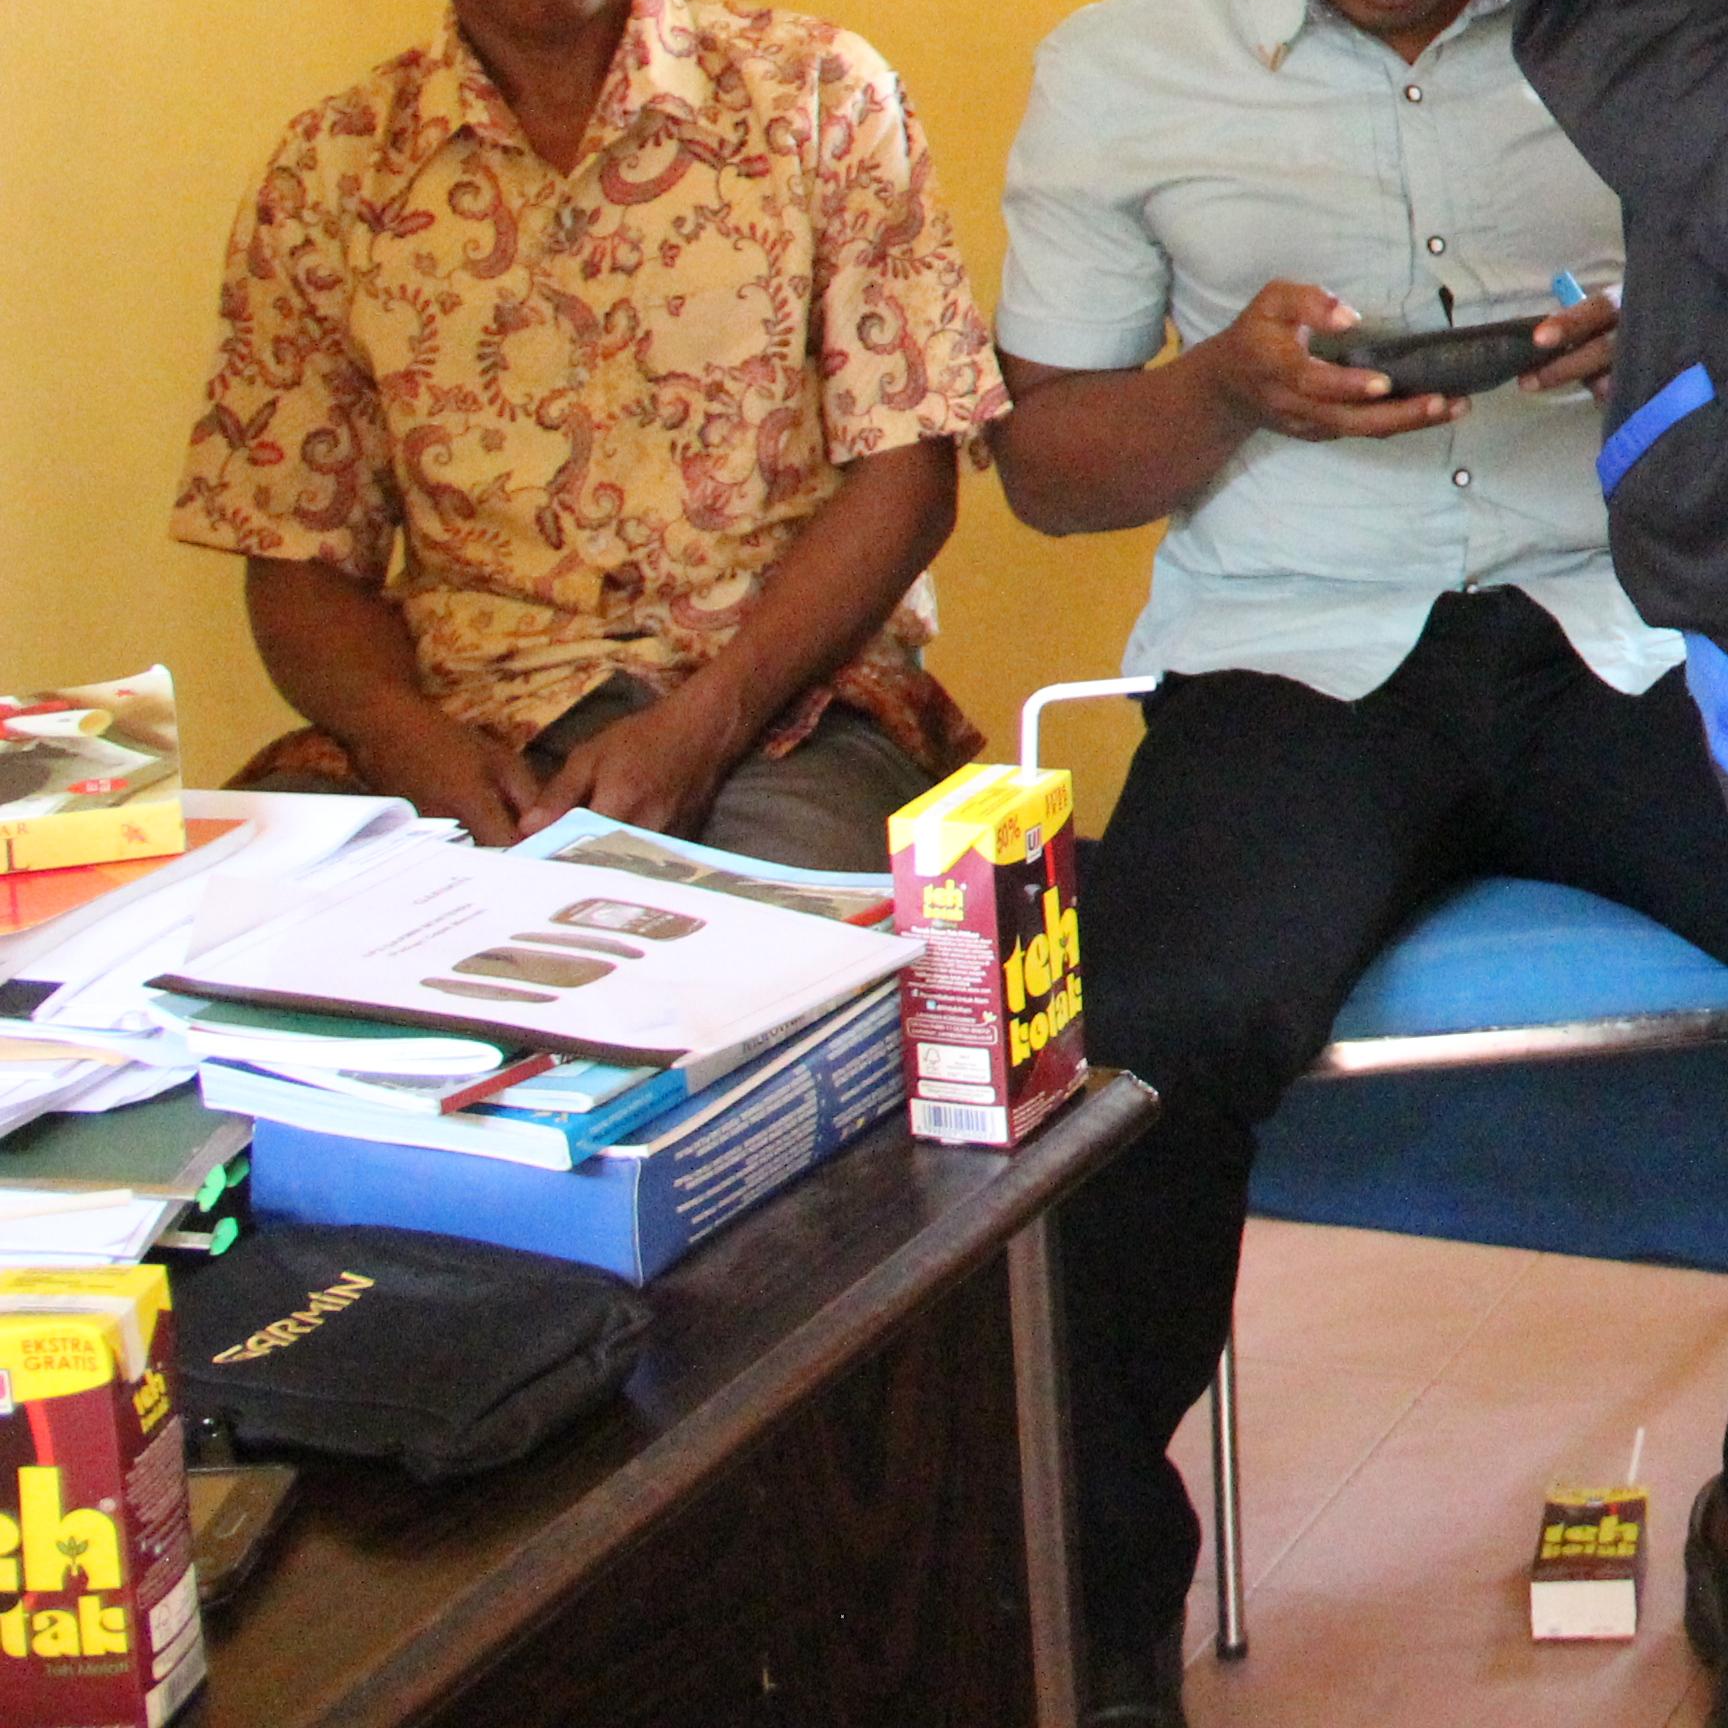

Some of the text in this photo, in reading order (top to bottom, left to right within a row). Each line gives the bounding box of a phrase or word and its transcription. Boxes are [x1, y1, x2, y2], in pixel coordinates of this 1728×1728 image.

[1003, 885, 1080, 1014] teh
[1009, 972, 1083, 1067] kotak
[21, 1337, 96, 1354] EKSTRA
[212, 1271, 377, 1364] GARMIN
[23, 1356, 98, 1373] GRATIS
